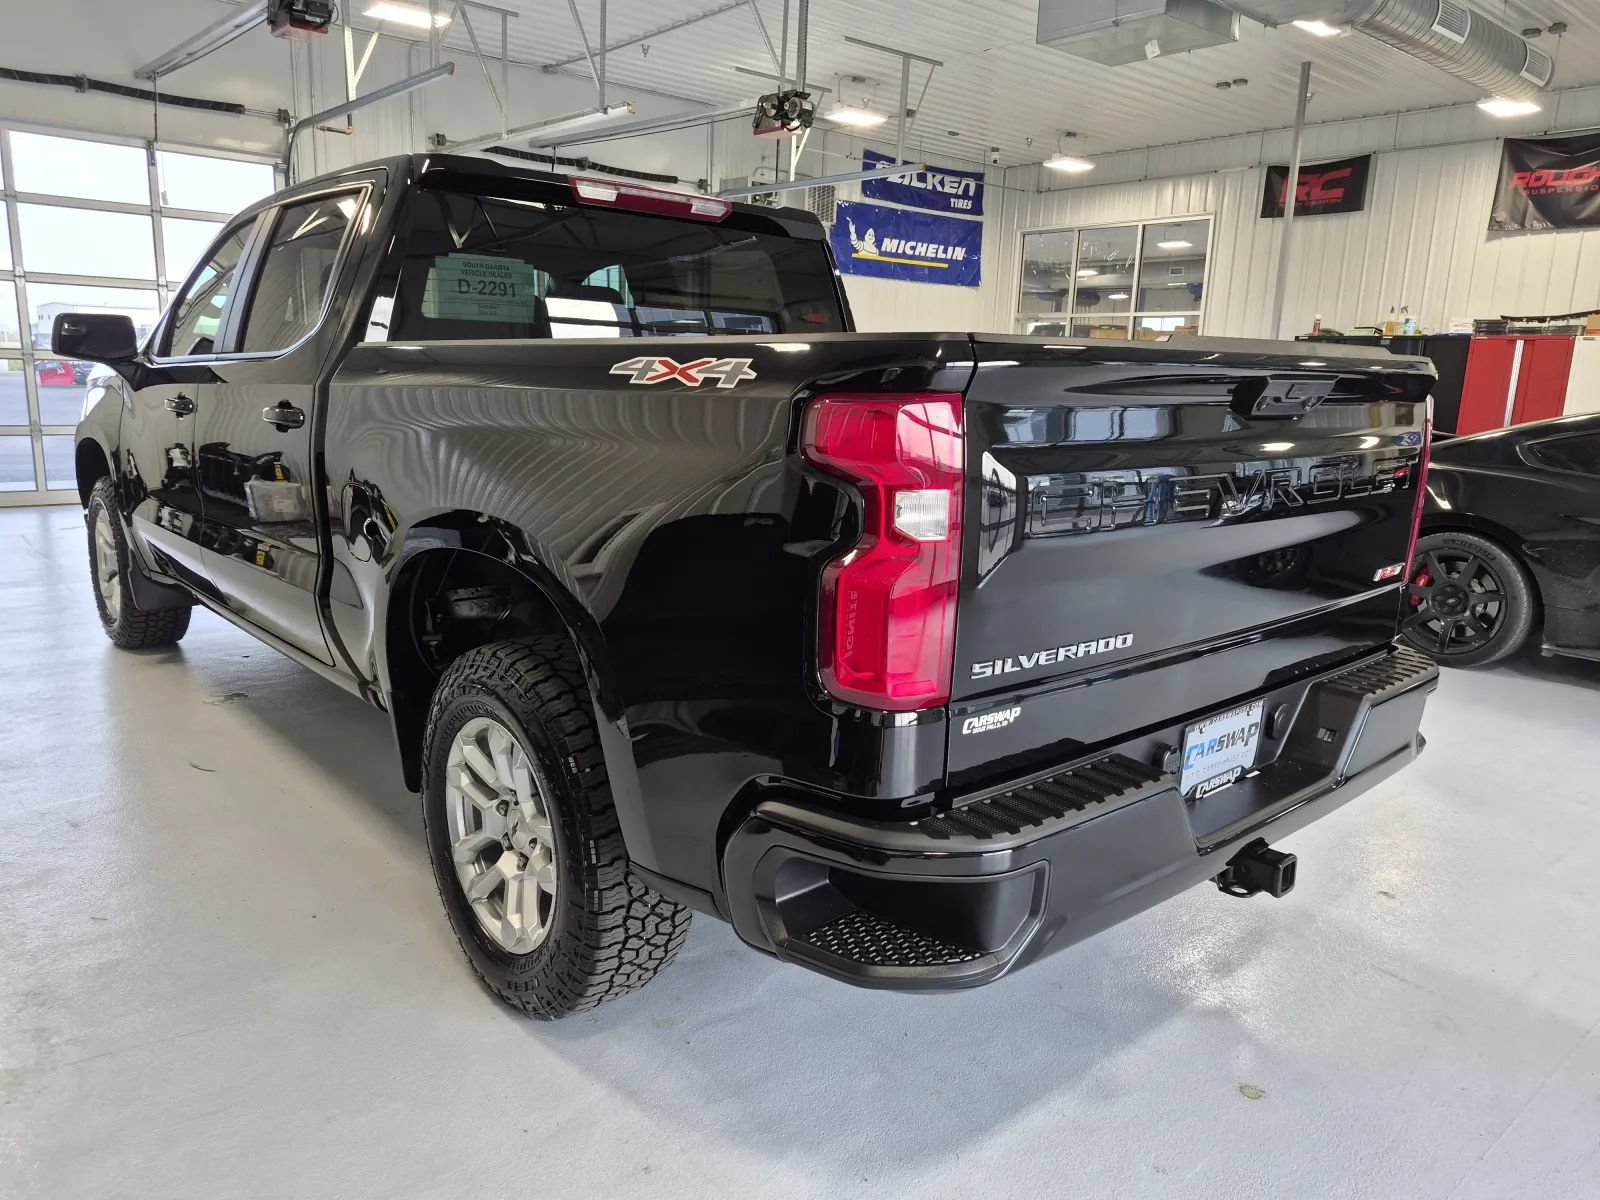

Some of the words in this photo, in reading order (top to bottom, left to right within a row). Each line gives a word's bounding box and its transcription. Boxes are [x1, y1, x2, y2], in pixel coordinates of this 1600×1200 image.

[950, 197, 973, 209] TIRES
[881, 237, 966, 260] MICHELIN
[485, 264, 510, 272] DAKOTA
[457, 278, 516, 298] D-2291
[970, 632, 1134, 680] SILVERADO
[962, 706, 1022, 735] CARSWAP
[1183, 721, 1260, 771] CARSWAP
[1195, 766, 1242, 800] CARSWAP
